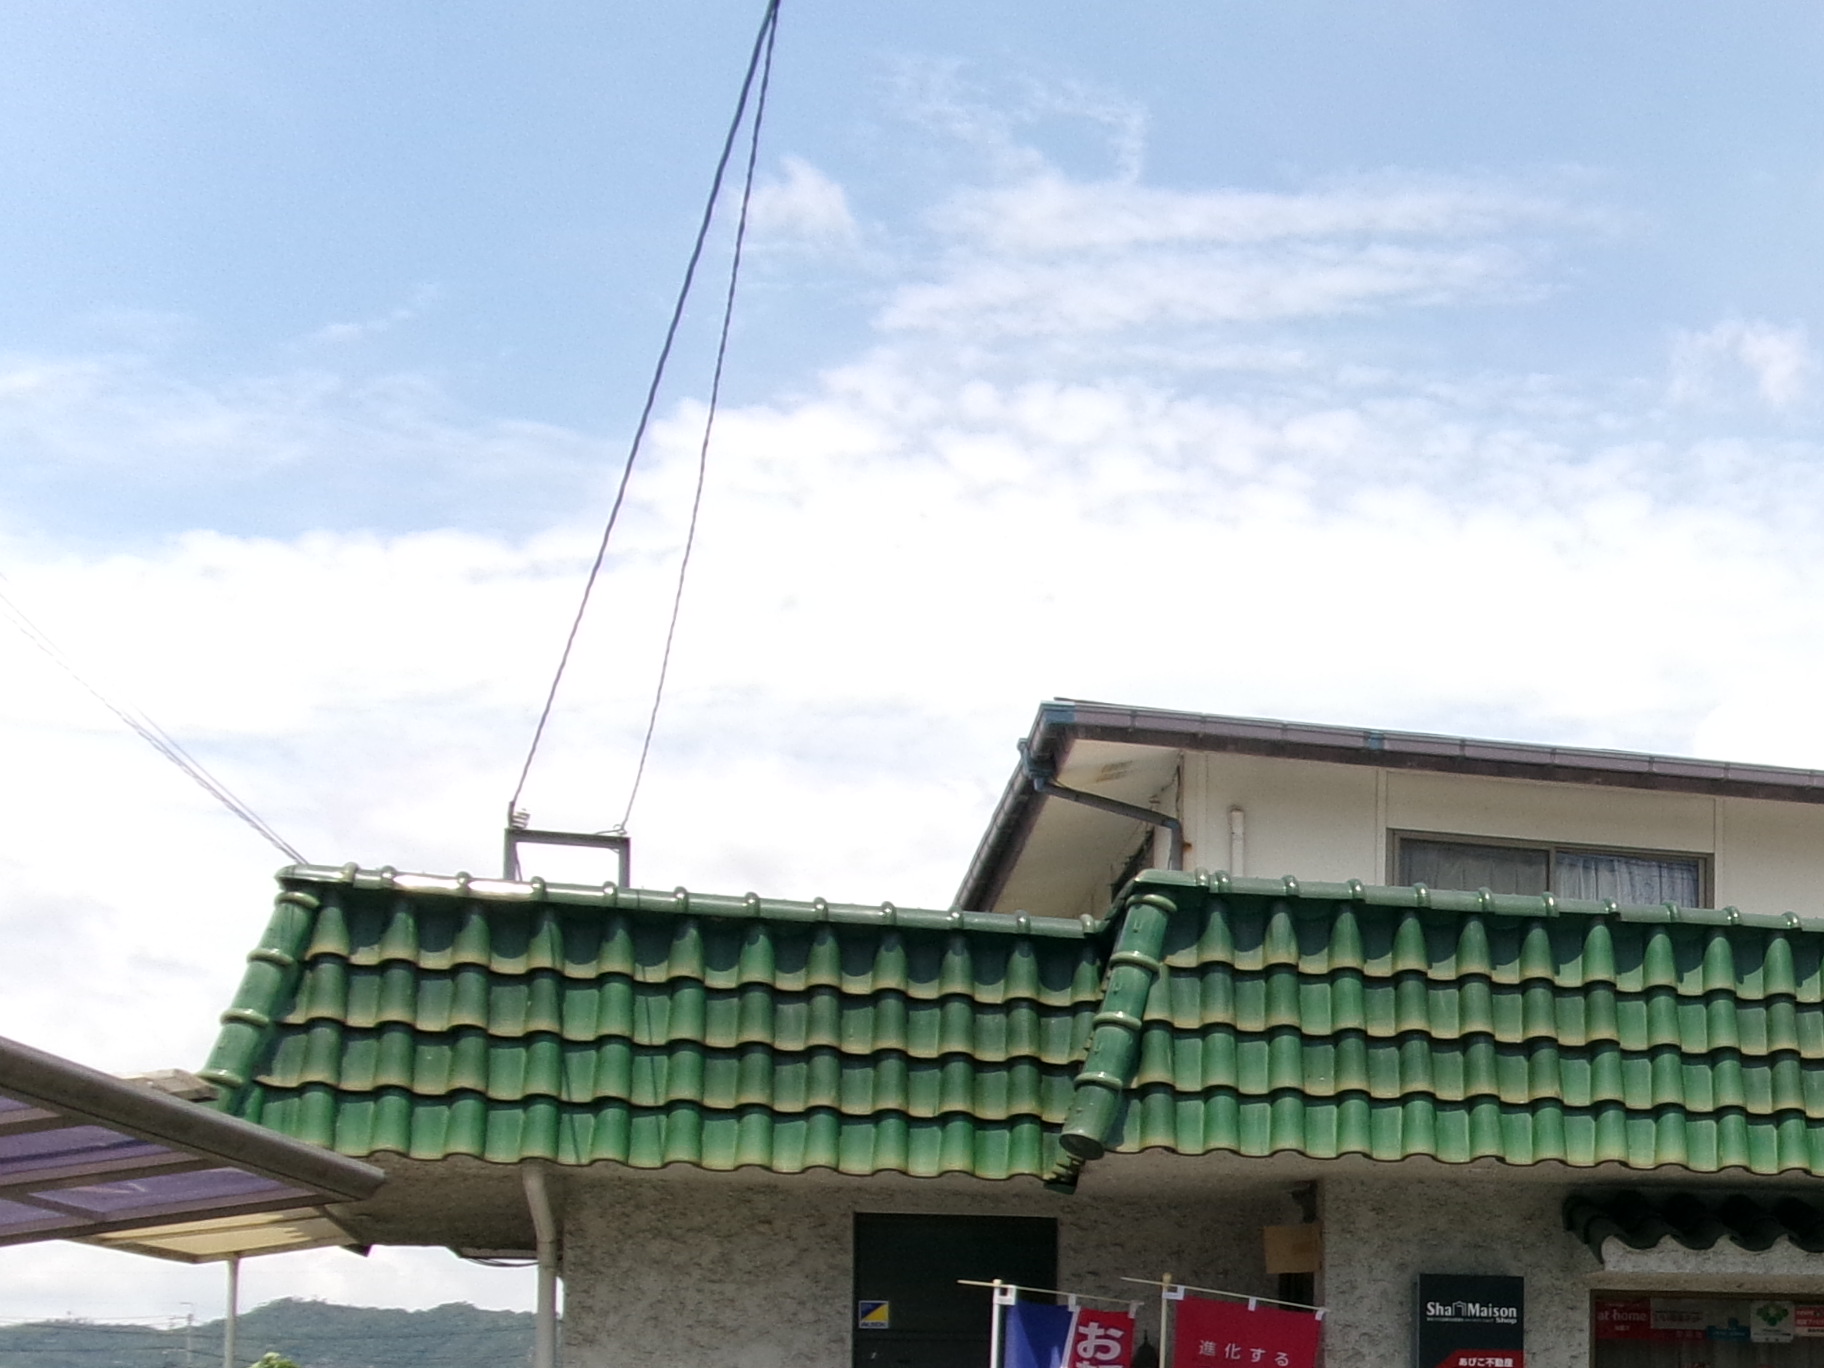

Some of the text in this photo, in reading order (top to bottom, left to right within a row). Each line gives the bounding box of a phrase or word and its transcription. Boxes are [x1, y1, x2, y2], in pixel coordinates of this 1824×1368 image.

[1426, 1302, 1517, 1318] Sha Maison
[1198, 1340, 1290, 1367] 進化する
[1458, 1357, 1514, 1368] あびこ不動産
